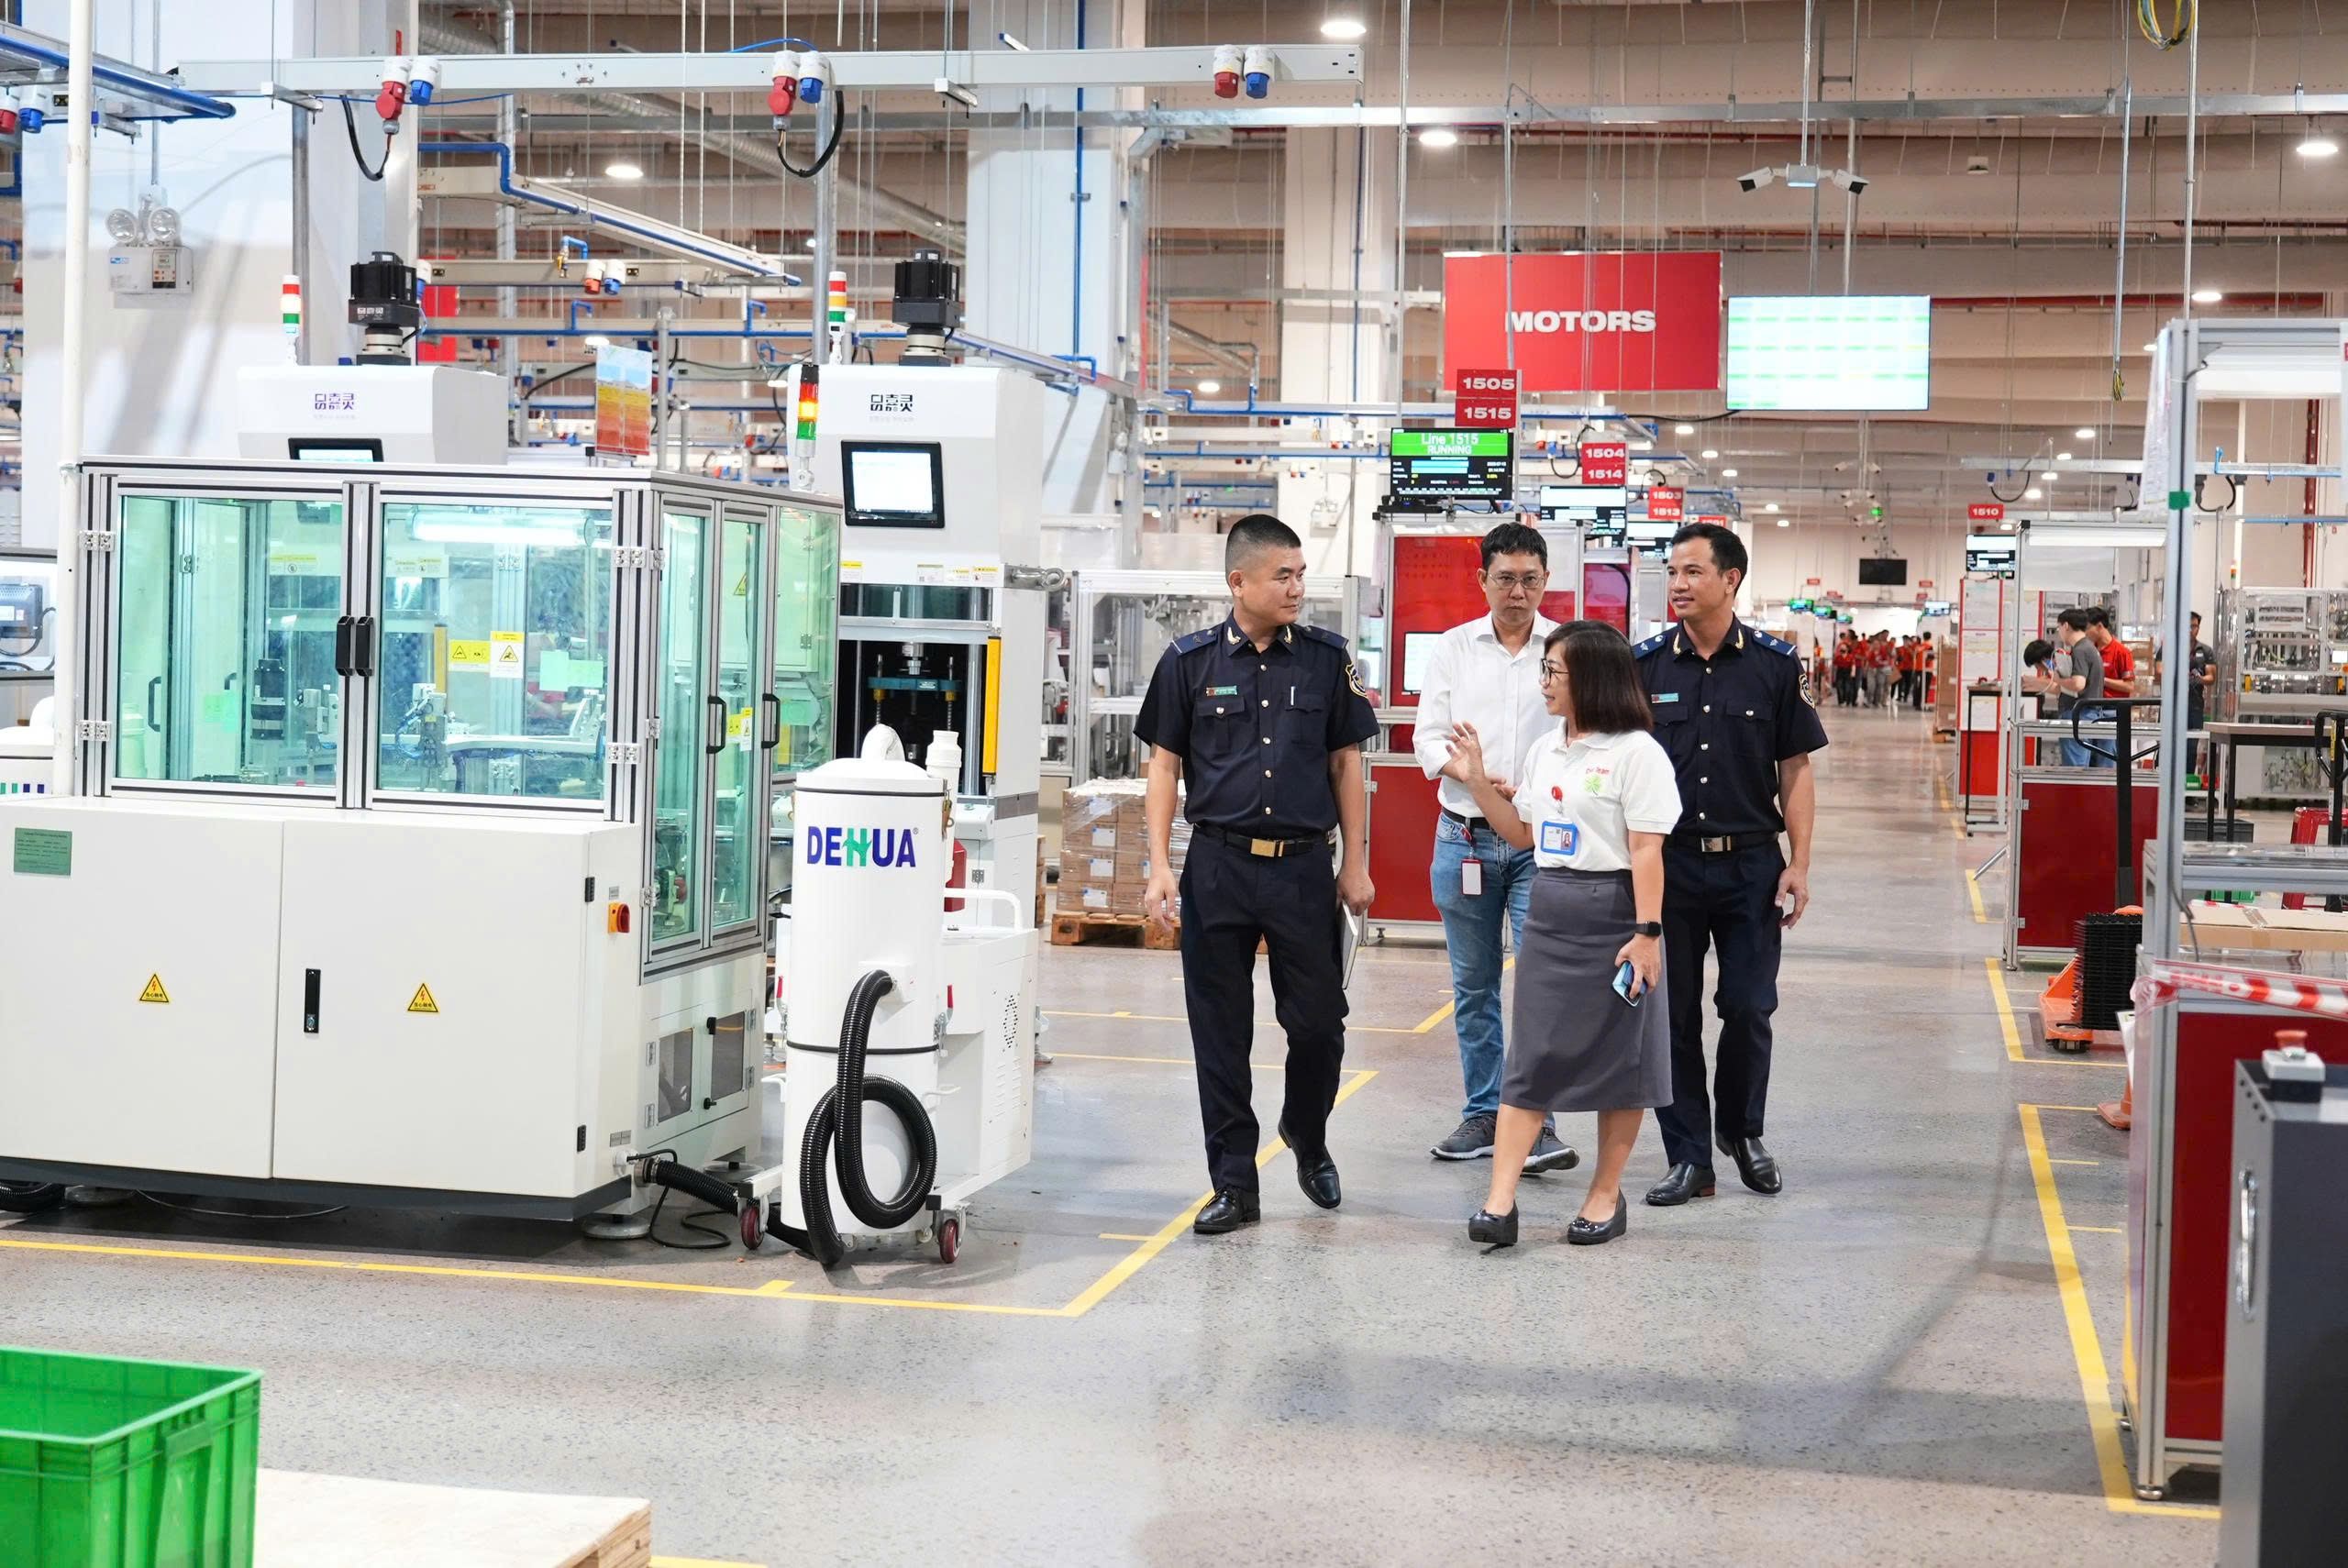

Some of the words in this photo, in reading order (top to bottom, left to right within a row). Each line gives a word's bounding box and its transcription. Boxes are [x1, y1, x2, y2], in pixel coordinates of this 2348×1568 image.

[1505, 310, 1656, 333] MOTORS
[1463, 376, 1515, 392] 1505
[1464, 406, 1512, 421] 1515
[1421, 433, 1446, 445] Line
[1451, 433, 1479, 445] 1515
[1428, 445, 1472, 455] RUNNING
[1586, 448, 1625, 458] 1504
[1588, 469, 1623, 479] 1514
[1653, 491, 1682, 500] 1503
[1653, 508, 1681, 516] 1513
[1973, 508, 1999, 516] 1510
[807, 826, 916, 867] DEHUA
